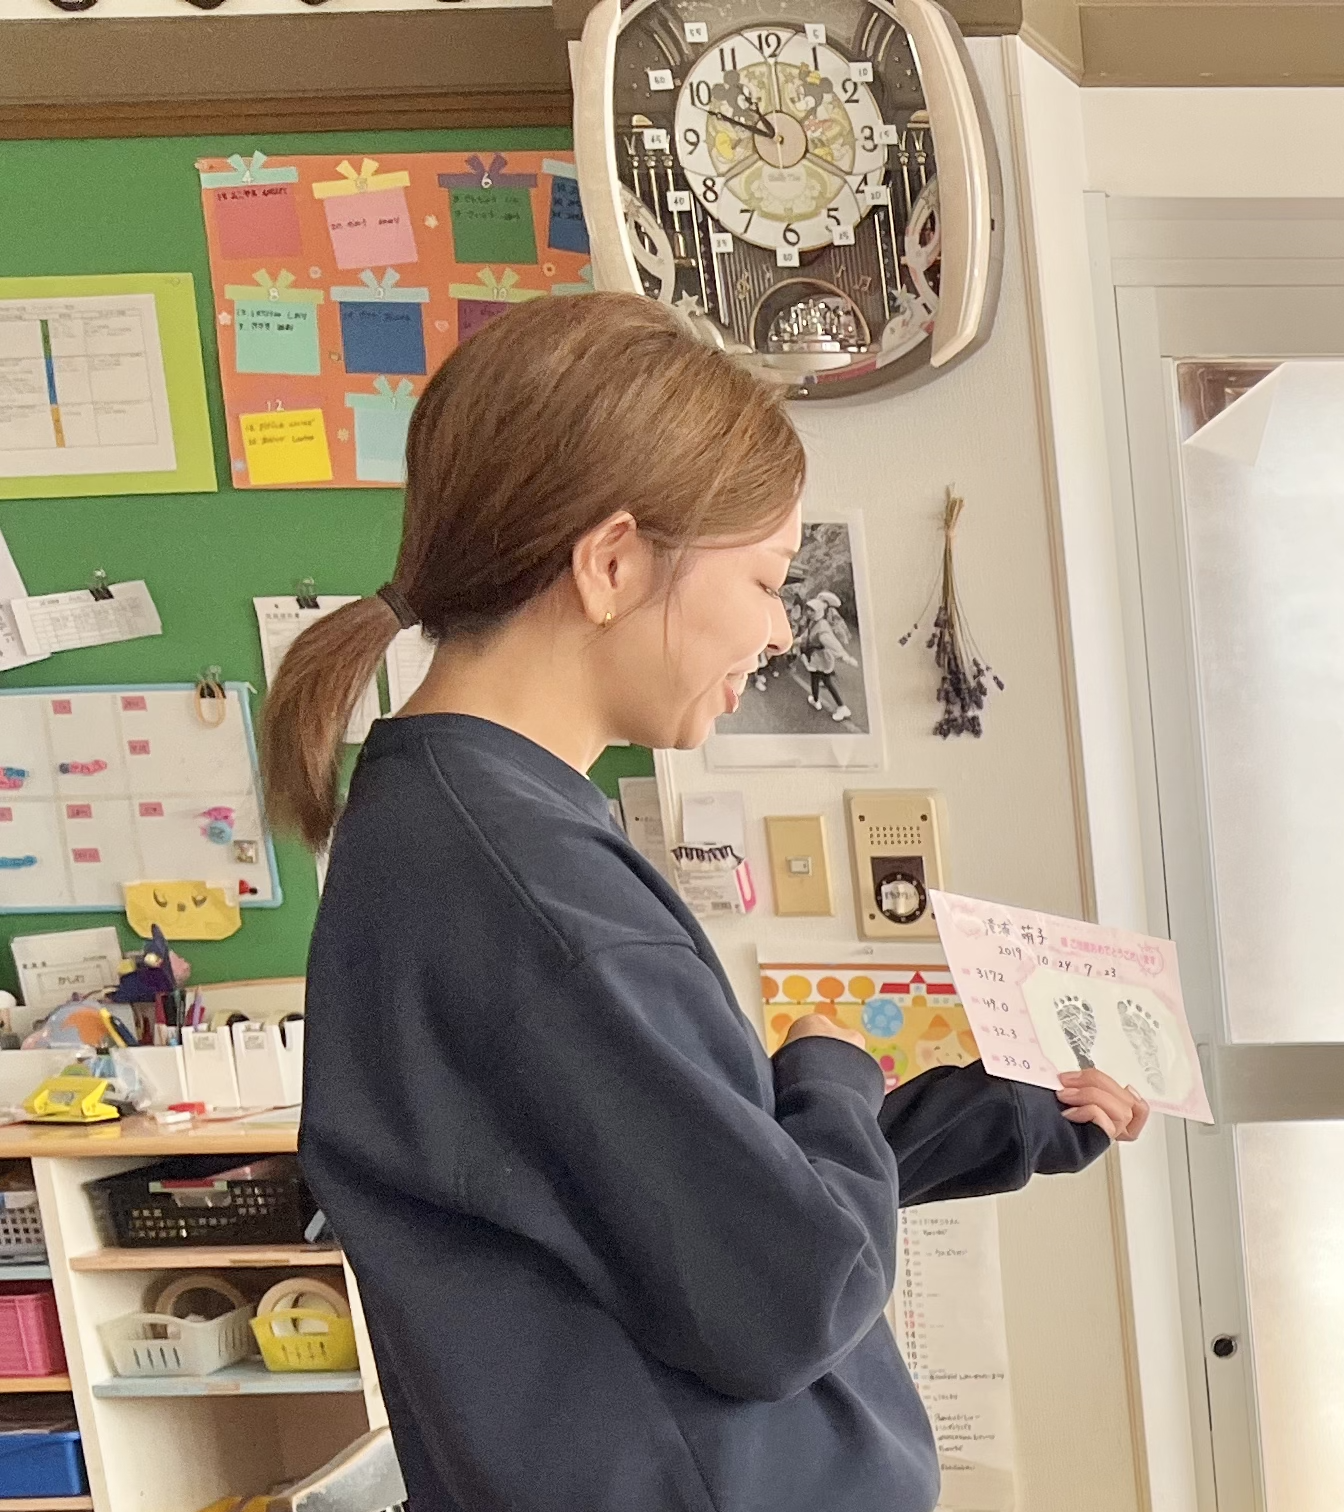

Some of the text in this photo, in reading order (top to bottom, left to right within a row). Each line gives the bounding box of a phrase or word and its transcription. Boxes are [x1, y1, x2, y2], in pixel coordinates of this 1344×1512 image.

[757, 32, 781, 58] 12
[719, 46, 737, 71] 11
[811, 46, 819, 71] 1
[858, 68, 869, 77] 10
[689, 80, 711, 106] 10
[842, 78, 859, 103] 2
[683, 128, 700, 155] 9
[861, 125, 878, 152] 3
[481, 172, 493, 188] 6
[703, 177, 719, 203] 8
[673, 196, 685, 206] 40
[740, 208, 756, 234] 7
[825, 207, 841, 233] 5
[783, 223, 801, 247] 6
[269, 287, 280, 300] 8
[266, 399, 285, 412] 12
[998, 945, 1116, 978] 2019 10 24 7 23
[976, 967, 1005, 983] 3172
[982, 996, 1009, 1013] 49.0
[992, 1025, 1018, 1040] 32.3
[1003, 1055, 1031, 1070] 33.0
[902, 1289, 913, 1298] 10
[904, 1310, 914, 1319] 12
[905, 1321, 915, 1329] 13
[906, 1331, 915, 1339] 14
[907, 1352, 917, 1360] 16
[908, 1362, 917, 1370] 17
